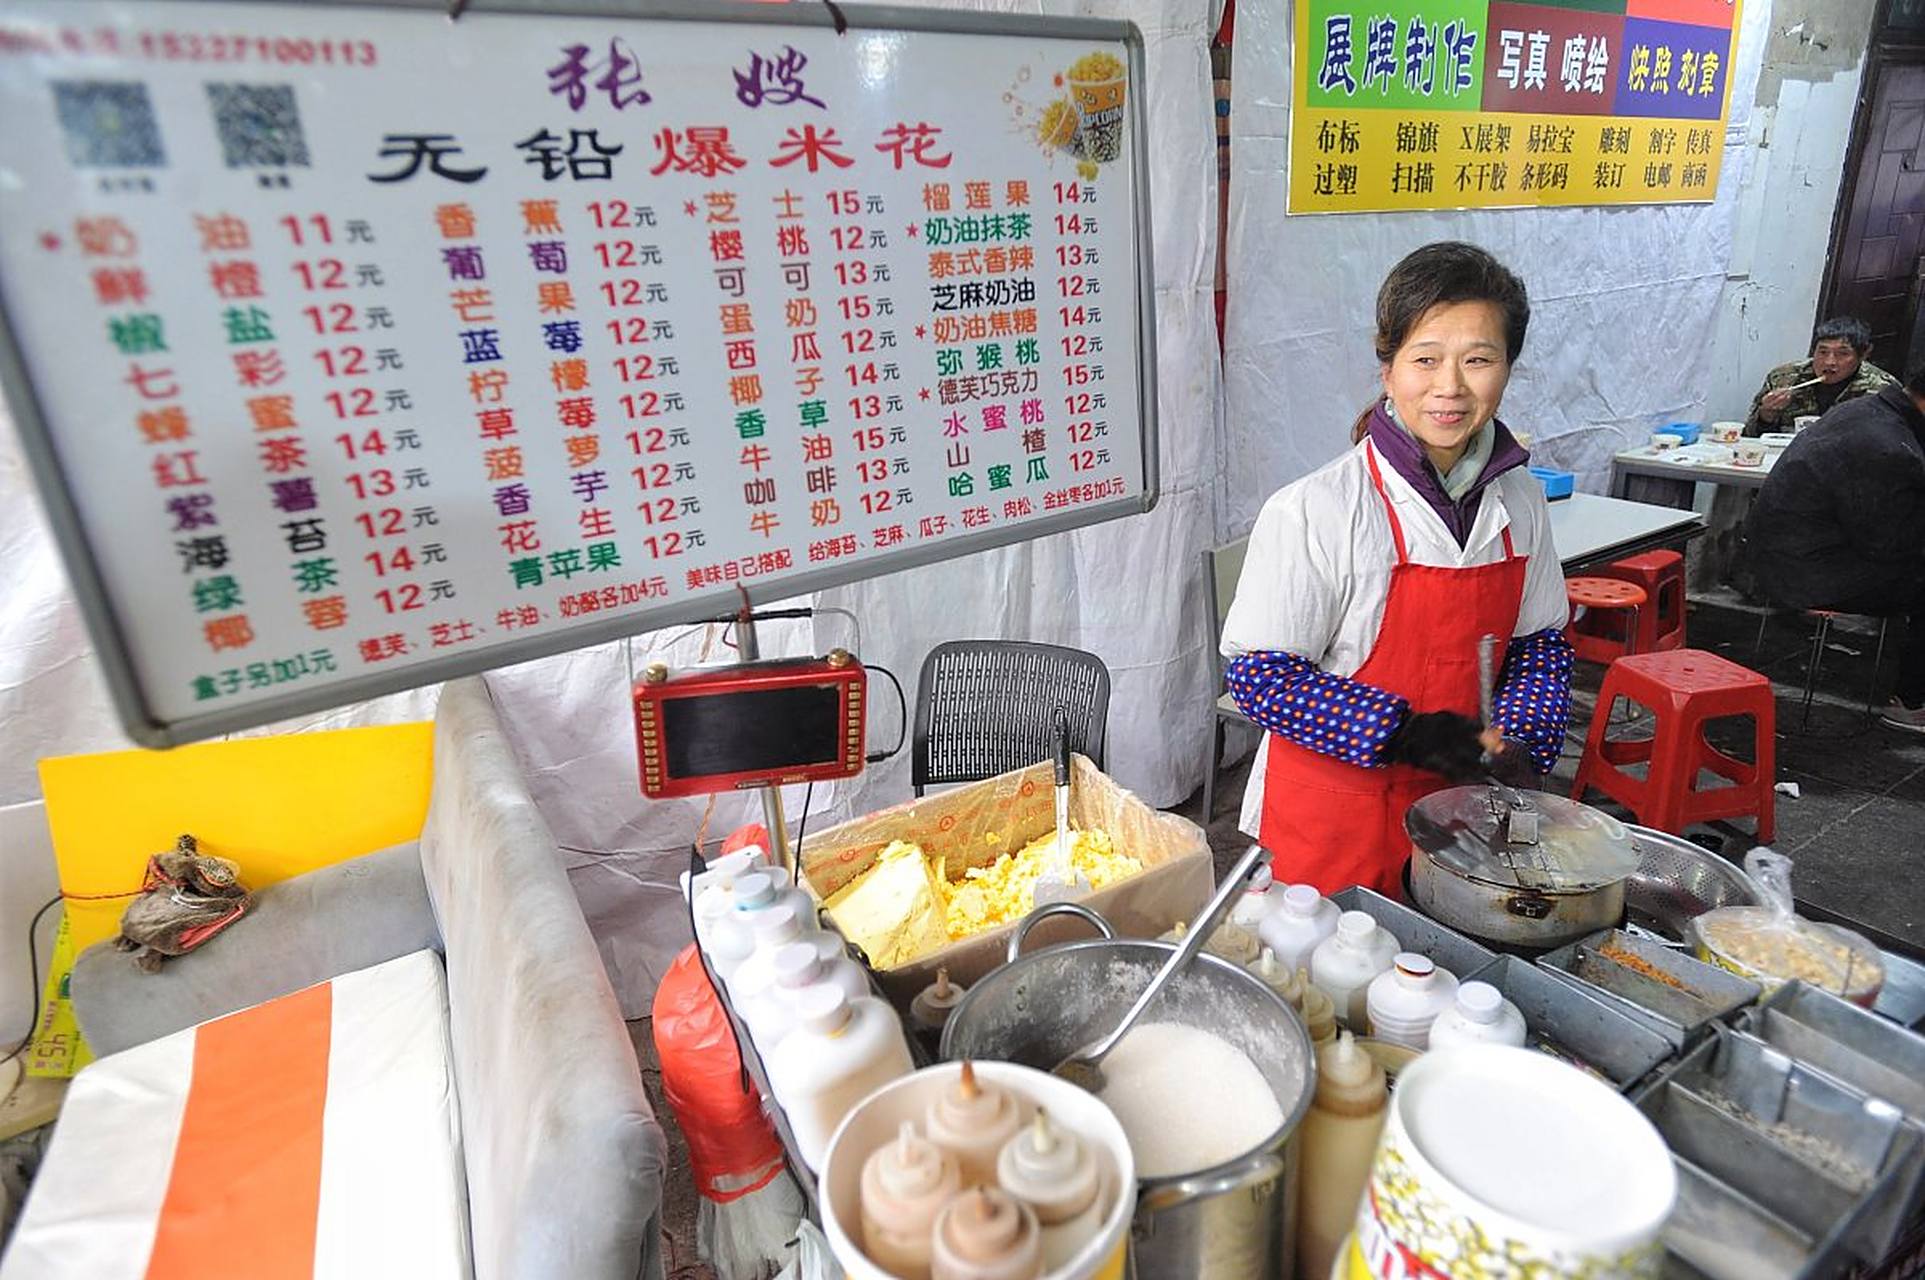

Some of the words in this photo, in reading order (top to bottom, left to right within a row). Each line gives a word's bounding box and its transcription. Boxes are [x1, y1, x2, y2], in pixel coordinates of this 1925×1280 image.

[1319, 14, 1477, 97] 展牌制作
[1497, 30, 1550, 93] 写真
[1560, 33, 1609, 94] 喷绘
[1628, 44, 1672, 95] 快照
[1678, 48, 1719, 98] 刻章
[367, 122, 954, 184] 无铅爆米花
[1316, 120, 1360, 154] 布标
[1396, 121, 1440, 153] 锦旗
[1460, 123, 1511, 153] X展架
[1526, 124, 1575, 153] 易拉宝
[1599, 127, 1632, 154] 雕刻
[1686, 128, 1712, 155] 传真
[922, 180, 1030, 212] 榴莲果
[1053, 181, 1097, 204] 14元
[1314, 163, 1357, 195] 过塑
[1392, 162, 1435, 194] 扫描
[1454, 162, 1509, 192] 不干胶
[1520, 162, 1568, 191] 条形码
[1594, 162, 1626, 188] 装订
[435, 199, 563, 238] 香蕉
[586, 201, 657, 228] 12元
[704, 189, 804, 223] 芝士
[826, 191, 884, 215] 15元
[281, 213, 374, 244] 11元
[710, 225, 809, 261] 樱桃
[830, 226, 887, 250] 12元
[925, 212, 1032, 245] 奶油抹茶
[1054, 214, 1098, 236] 14元
[292, 259, 384, 290] 12元
[441, 240, 567, 280] 葡萄
[593, 240, 662, 268] 12元
[714, 262, 811, 298] 可可
[834, 261, 890, 285] 13元
[929, 246, 1035, 279] 泰式香辣
[1056, 245, 1099, 266] 13元
[450, 281, 575, 322] 芒果
[600, 280, 668, 307] 12元
[930, 277, 1036, 313] 芝麻奶油
[1057, 275, 1100, 297] 12元
[302, 303, 394, 334] 12元
[719, 298, 816, 335] 蛋奶
[838, 296, 893, 320] 15元
[933, 308, 1037, 344] 奶油焦糖
[1059, 306, 1102, 328] 14元
[459, 321, 582, 363] 蓝莓
[607, 318, 673, 345] 12元
[724, 332, 821, 369] 西瓜
[842, 329, 896, 353] 12元
[937, 339, 1040, 376] 弥猴桃
[1061, 336, 1103, 356] 12元
[125, 351, 287, 398] 七彩
[313, 346, 403, 377] 12元
[467, 359, 590, 403] 柠檬
[613, 355, 679, 382] 12元
[728, 367, 824, 406] 椰子
[845, 362, 900, 386] 14元
[938, 368, 1038, 405] 德芙巧克力
[1063, 365, 1105, 385] 15元
[325, 387, 412, 418] 12元
[475, 397, 596, 440] 草莓
[619, 392, 684, 419] 12元
[735, 399, 829, 439] 香草
[848, 396, 903, 419] 13元
[943, 399, 1045, 438] 水蜜桃
[1065, 394, 1106, 414] 12元
[336, 429, 420, 459] 14元
[485, 435, 599, 481] 菠萝
[626, 428, 690, 455] 12元
[740, 433, 832, 472] 牛油
[853, 427, 906, 451] 15元
[947, 428, 1047, 469] 山楂
[1067, 421, 1108, 443] 12元
[346, 469, 429, 500] 13元
[493, 471, 608, 516] 香芋
[632, 462, 695, 490] 12元
[744, 465, 837, 506] 咖啡
[856, 458, 910, 483] 13元
[949, 456, 1049, 498] 哈蜜瓜
[1069, 449, 1111, 472] 12元
[499, 508, 616, 555] 花生
[637, 497, 700, 525] 12元
[750, 498, 841, 539] 牛奶
[860, 488, 913, 515] 12元
[175, 518, 326, 573] 海苔
[354, 506, 438, 538] 12元
[508, 542, 622, 589] 青苹果
[643, 531, 706, 559] 12元
[192, 556, 338, 612] 绿茶
[364, 543, 447, 576] 14元
[685, 548, 792, 590] 美味自己搭配
[374, 580, 455, 614] 12元
